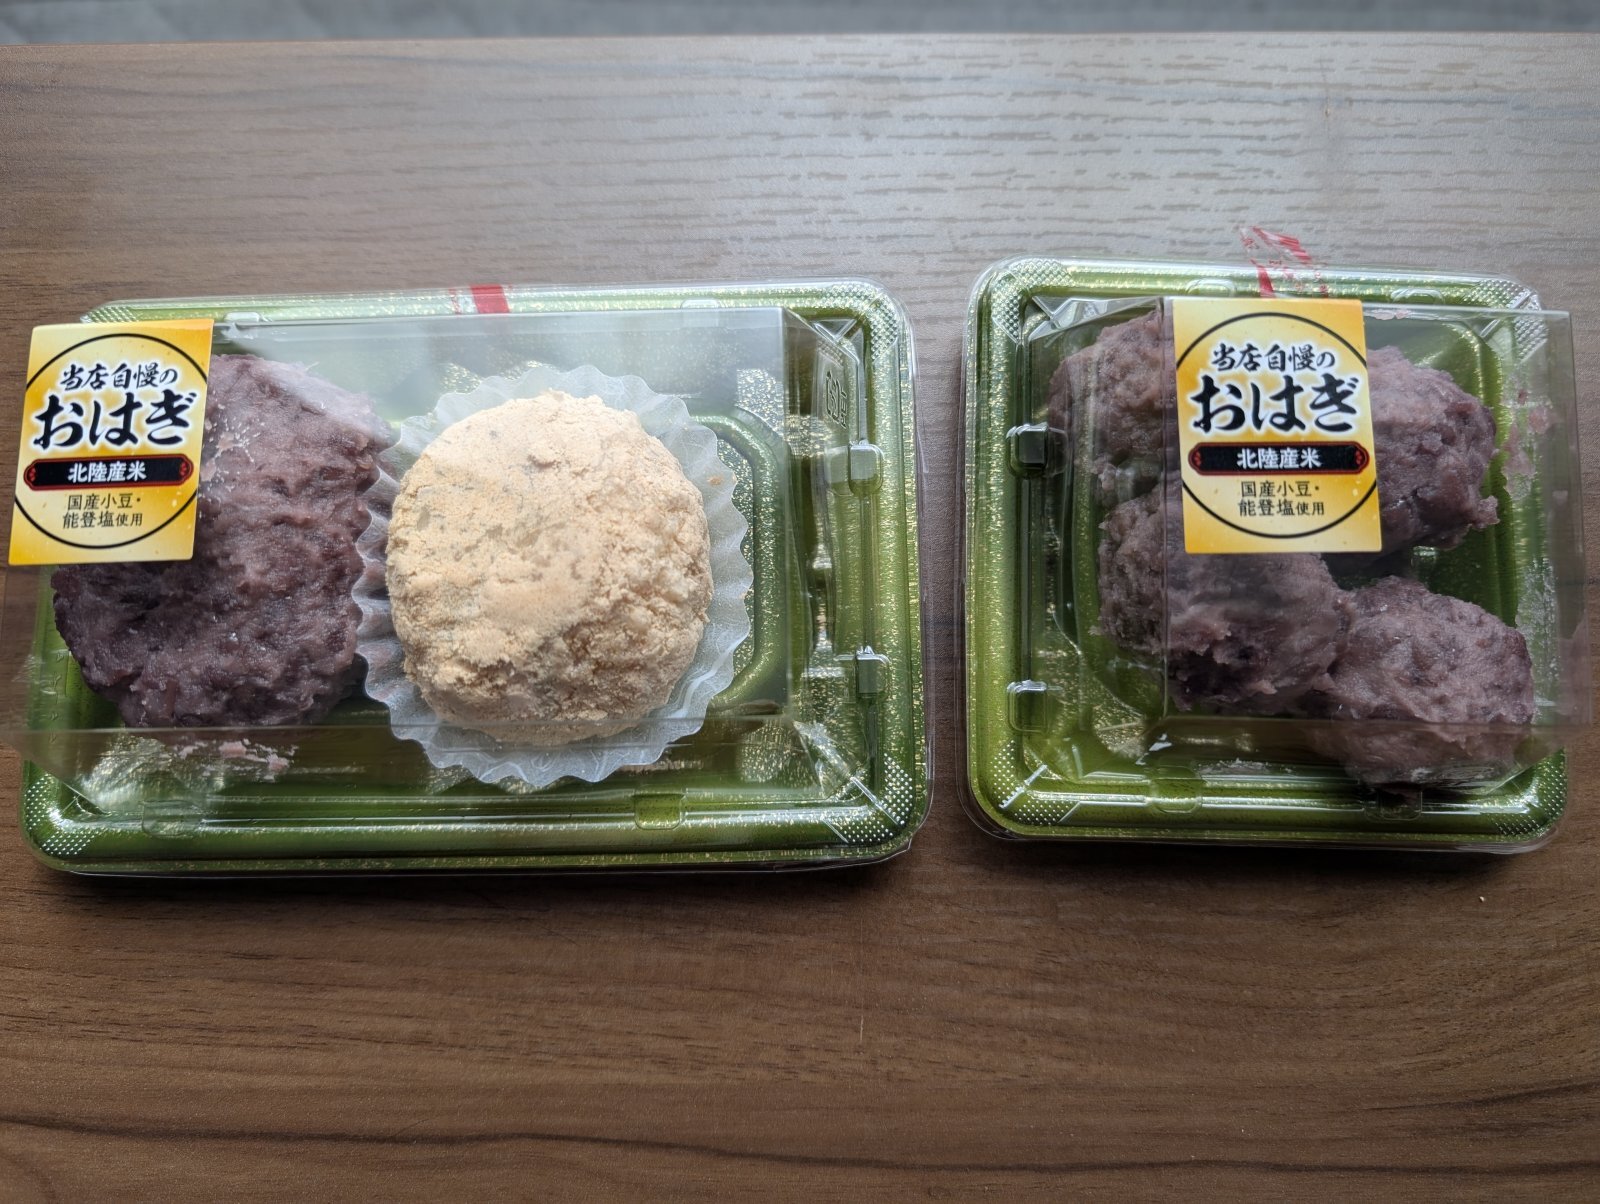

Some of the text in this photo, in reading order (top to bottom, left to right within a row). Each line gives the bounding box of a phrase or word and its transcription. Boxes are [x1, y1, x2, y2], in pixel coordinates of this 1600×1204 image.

[1211, 343, 1336, 371] 当店自慢の
[60, 362, 179, 390] 当店自慢の
[1191, 373, 1359, 433] おはぎ
[33, 389, 197, 450] おはぎ
[1237, 447, 1321, 470] 北陸産米
[68, 461, 147, 483] 北陸産米
[1238, 499, 1325, 517] 能登塩使用
[62, 513, 143, 529] 能登塩使用
